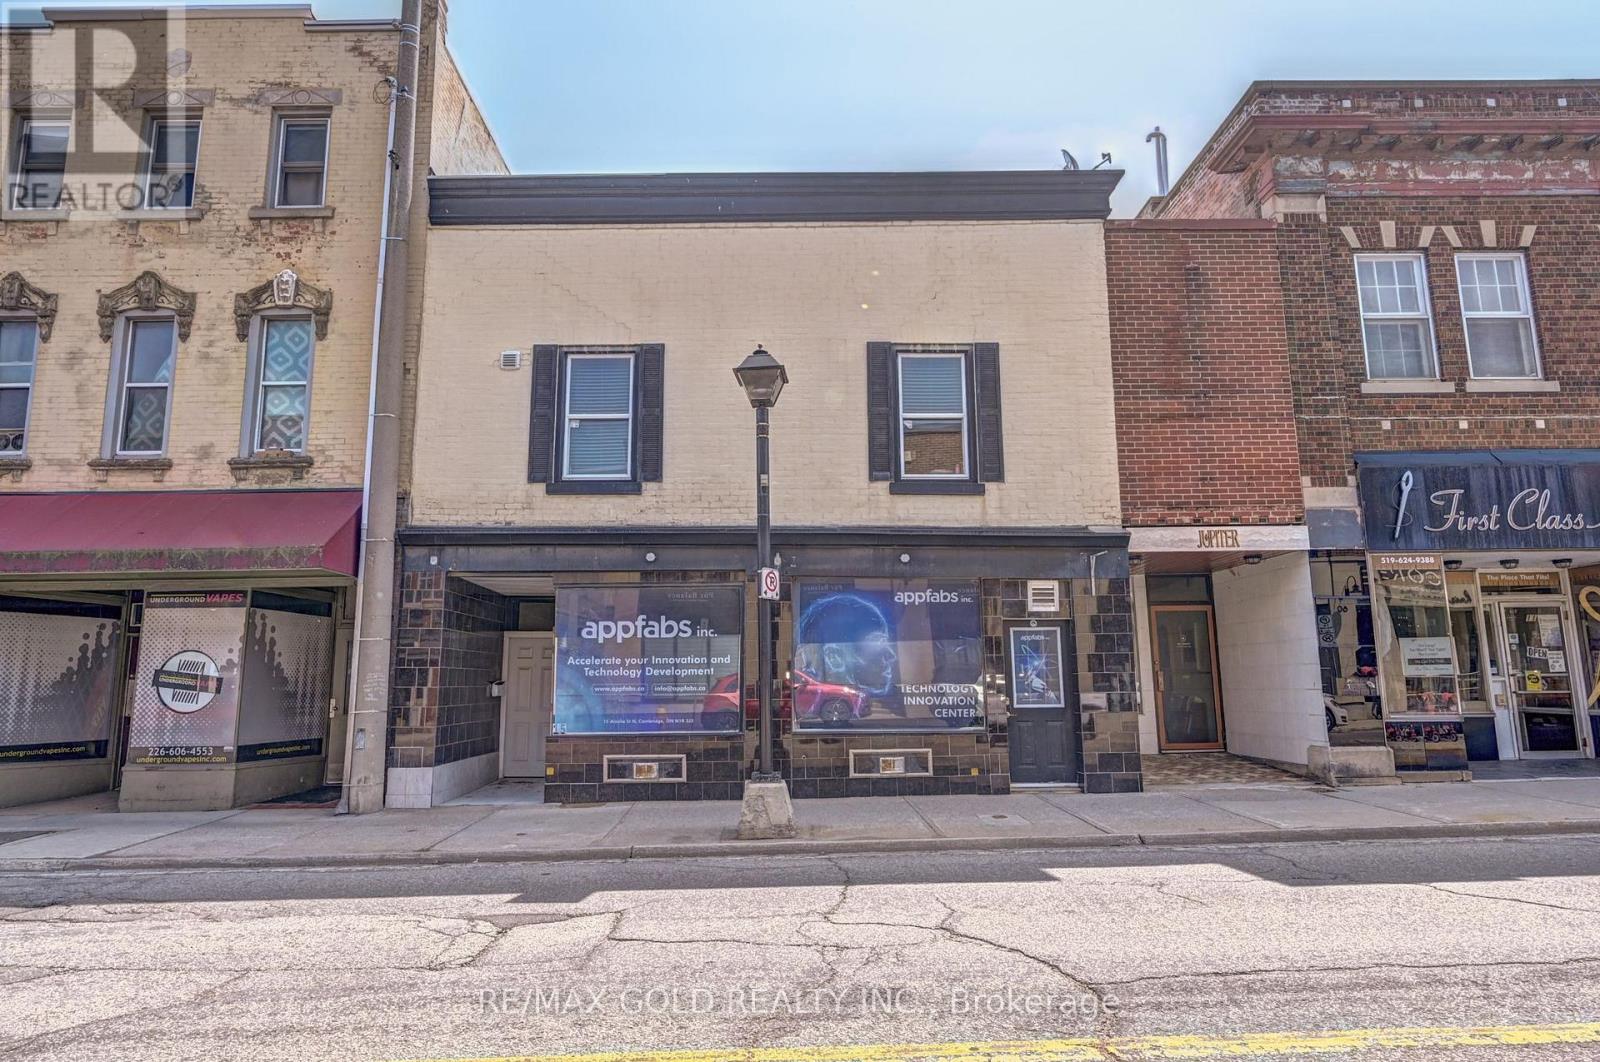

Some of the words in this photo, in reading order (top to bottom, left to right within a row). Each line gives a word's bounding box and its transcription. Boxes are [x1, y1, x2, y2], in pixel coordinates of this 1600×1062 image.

[1424, 489, 1500, 531] First
[1507, 487, 1584, 531] Class
[1197, 529, 1240, 548] JUPITER
[1381, 556, 1435, 564] 519-624-9388
[206, 593, 244, 603] VAPES
[894, 588, 959, 605] appfabs
[581, 615, 692, 643] appfabs
[696, 626, 718, 637] inc.
[1528, 648, 1548, 658] OPEN
[568, 656, 621, 665] Accelerate
[625, 657, 648, 666] your
[652, 655, 707, 664] Innovation
[711, 655, 731, 664] and
[584, 667, 642, 678] Technology
[645, 666, 714, 677] Development
[901, 683, 975, 693] TECHNOLOGY
[903, 696, 975, 705] INNOVATION
[934, 708, 976, 718] CENTER
[148, 747, 214, 756] 226-606-4553
